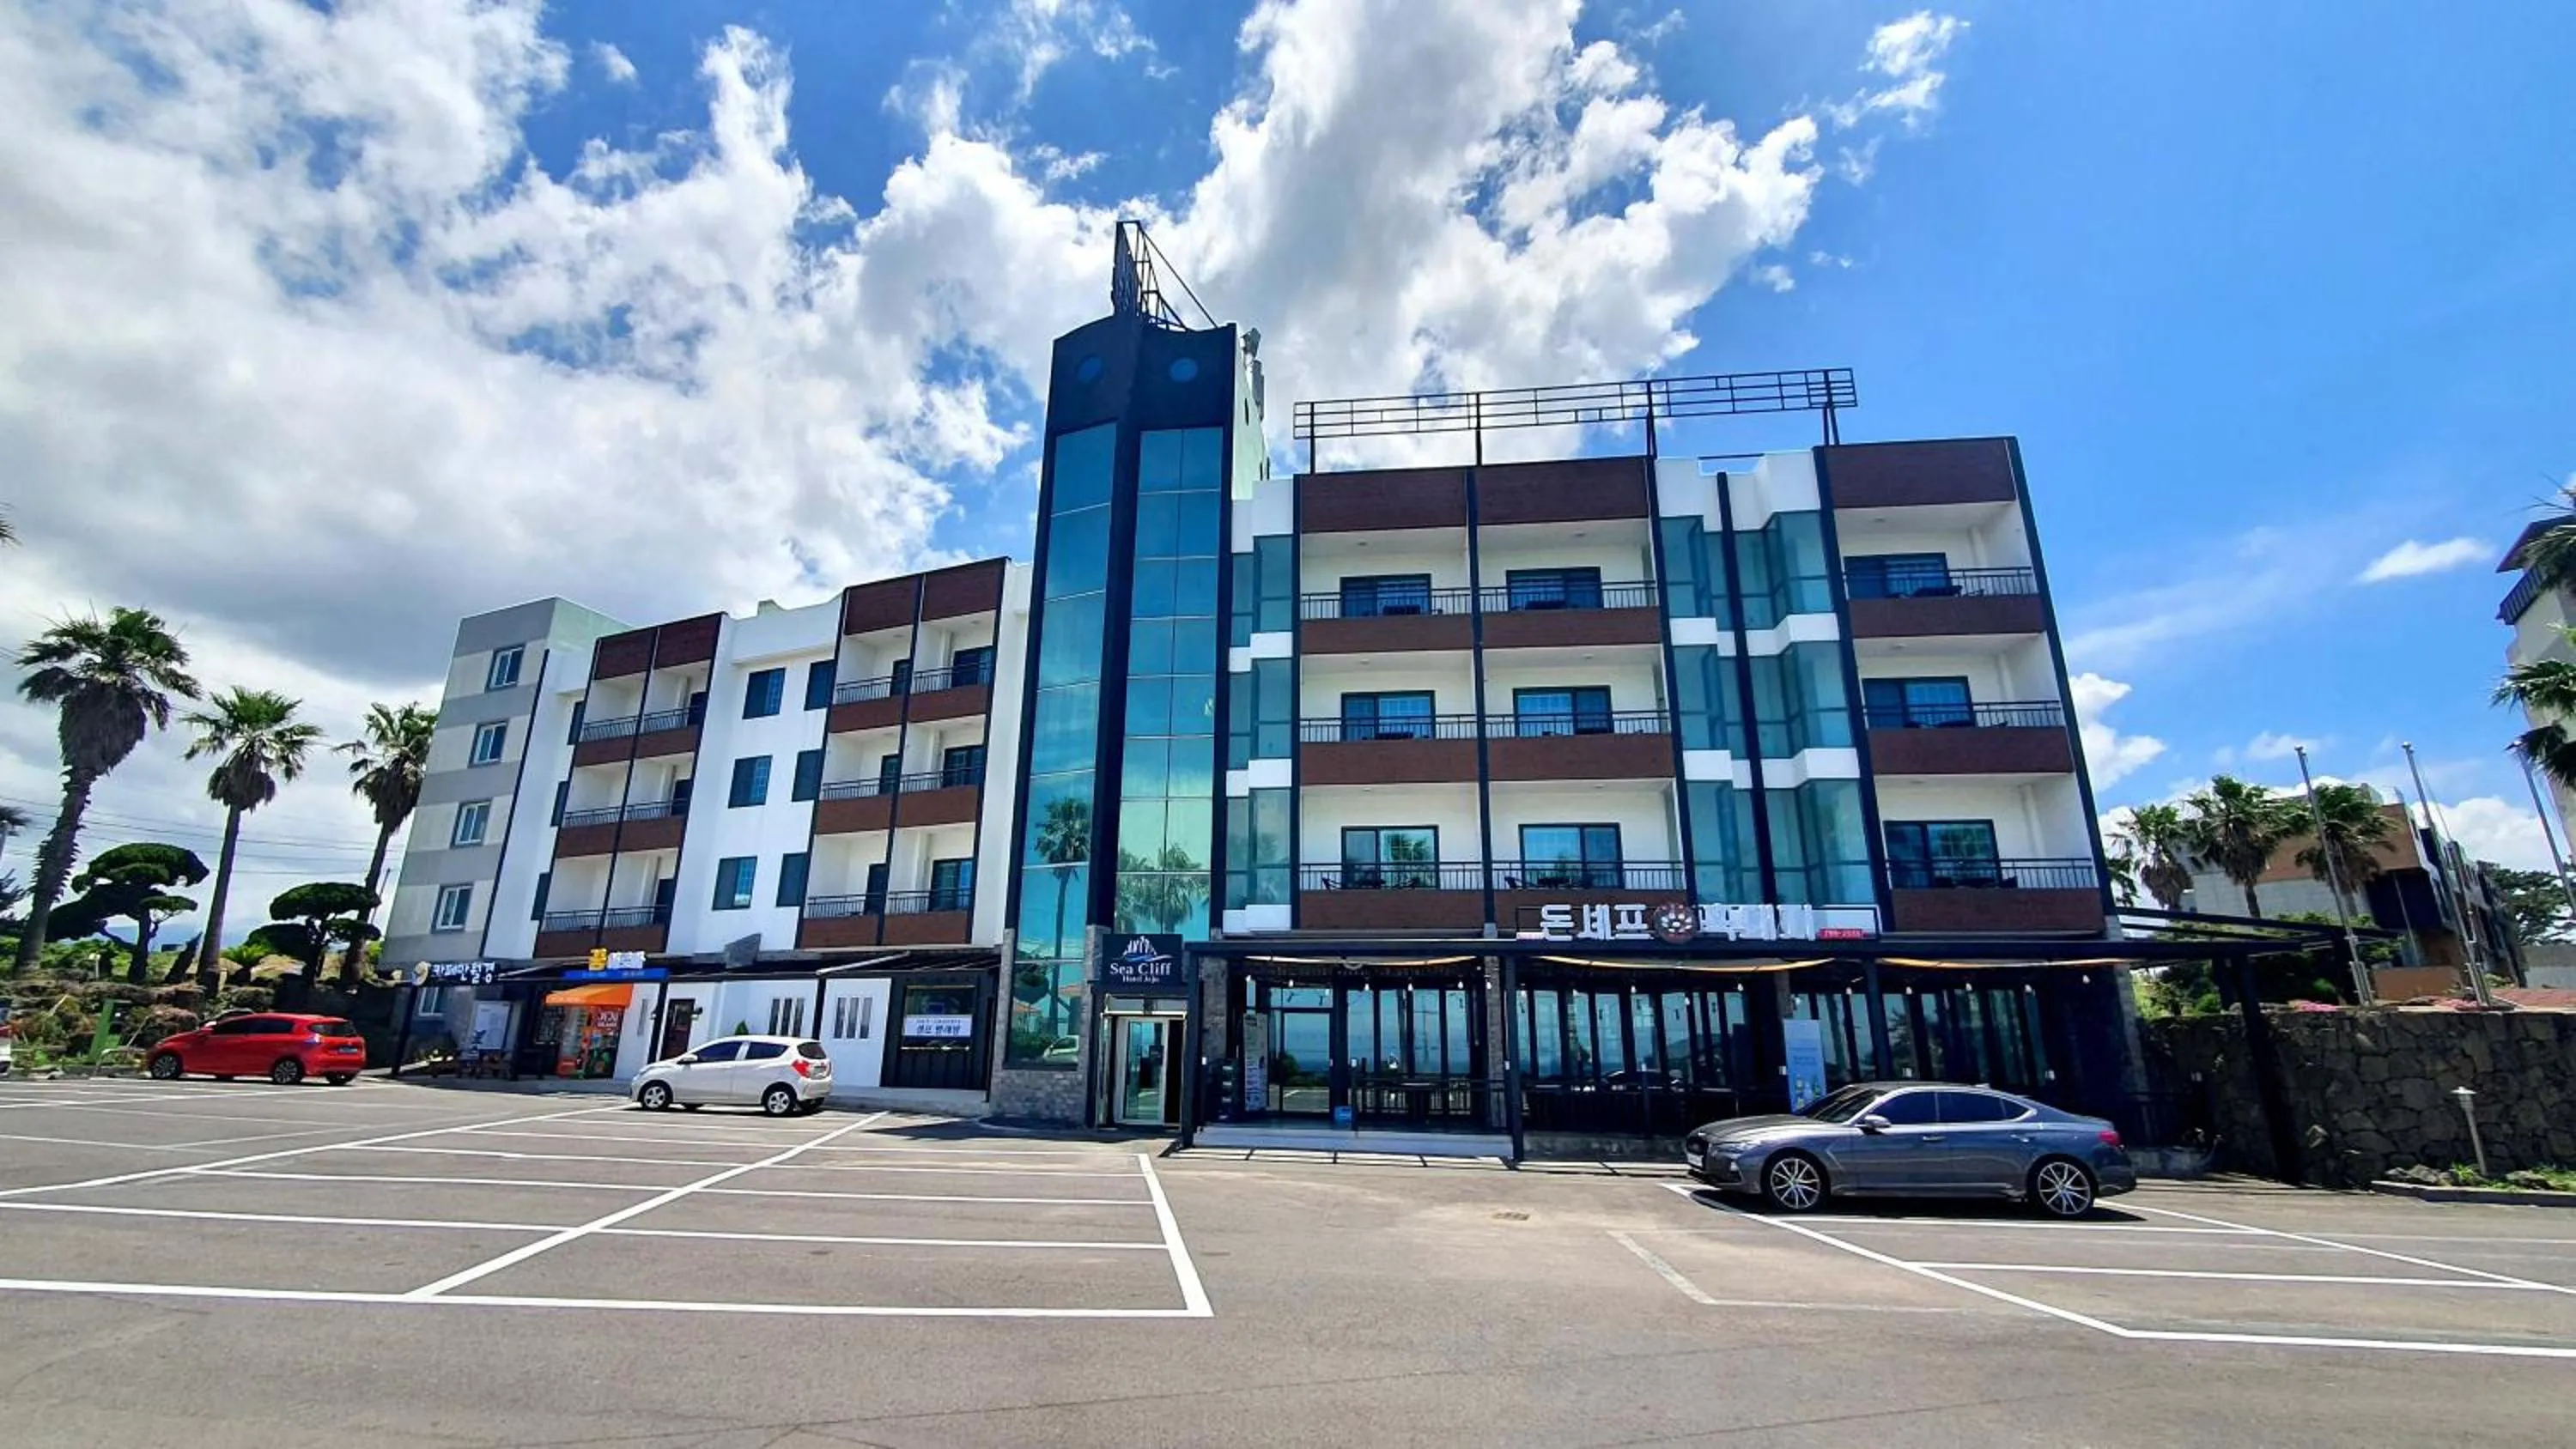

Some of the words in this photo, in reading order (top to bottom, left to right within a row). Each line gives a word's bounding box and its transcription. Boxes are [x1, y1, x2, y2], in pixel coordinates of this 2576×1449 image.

[1540, 904, 1654, 941] 돈셰프
[1109, 962, 1133, 975] Sea
[1138, 962, 1172, 975] Cliff
[1144, 975, 1160, 984] Jeju
